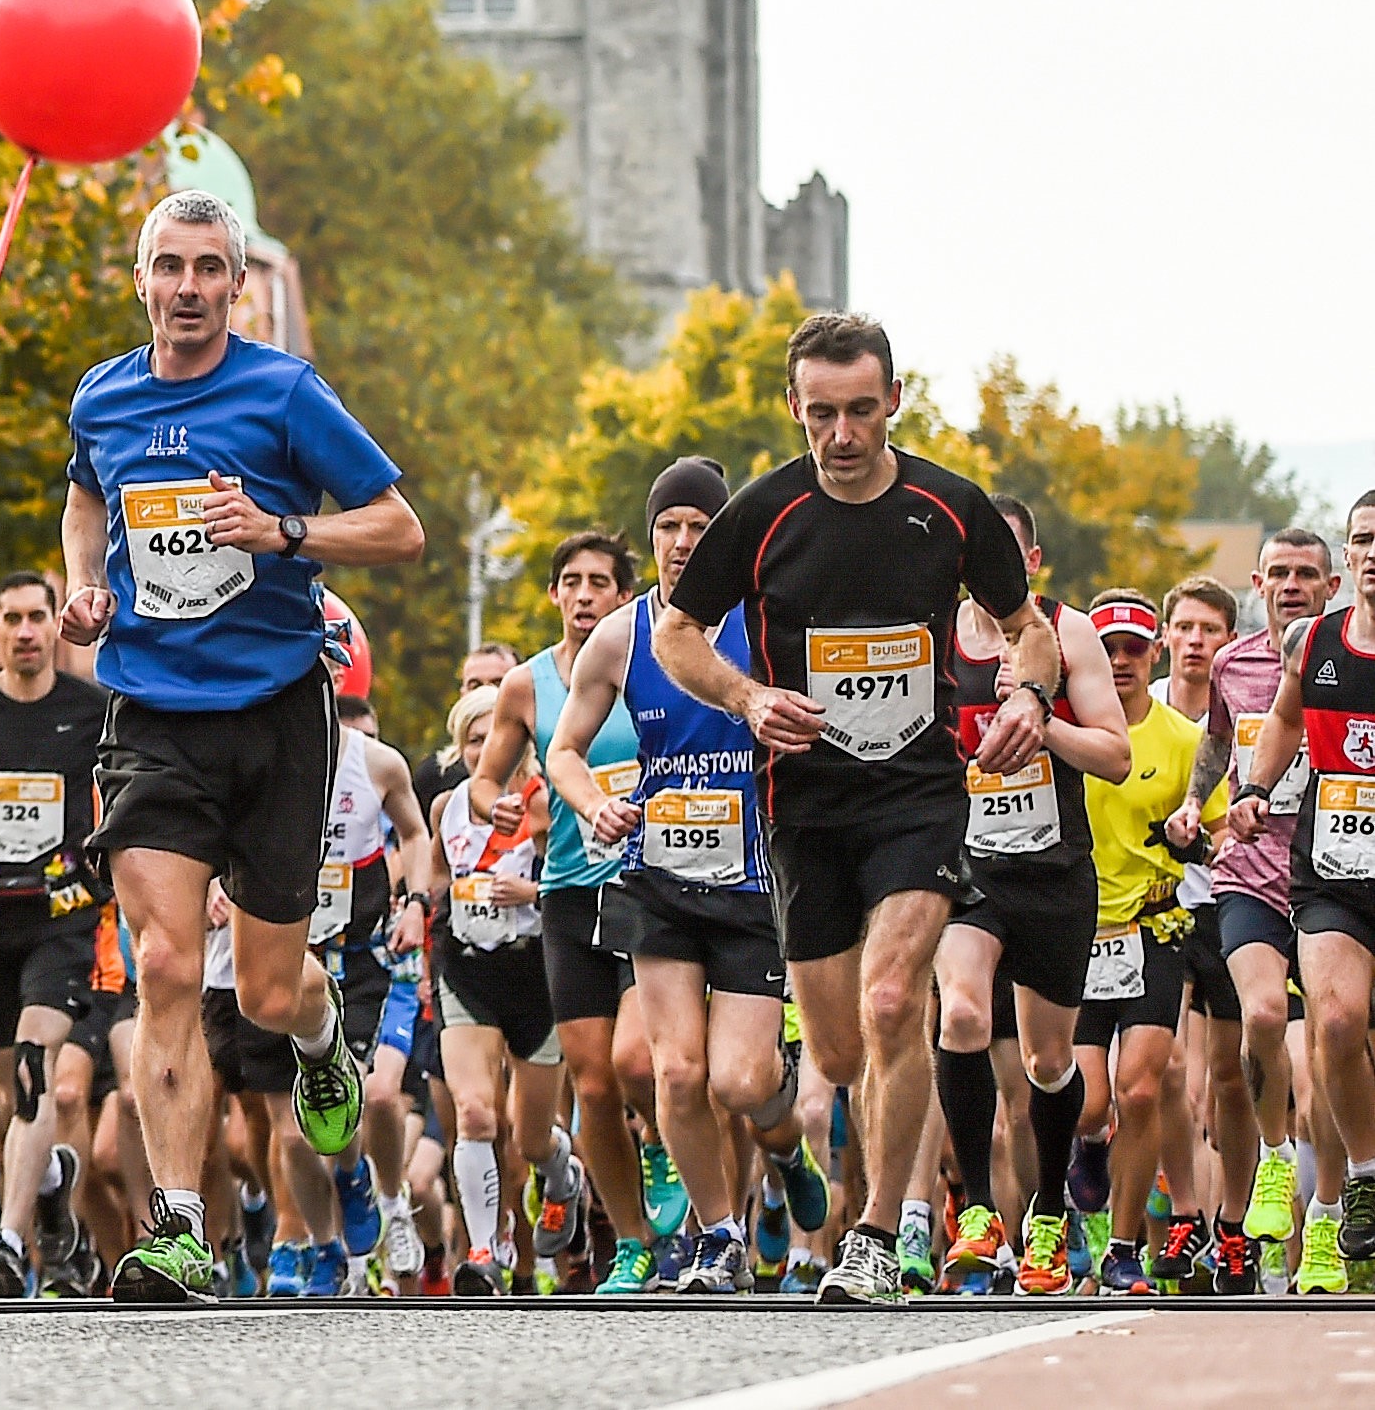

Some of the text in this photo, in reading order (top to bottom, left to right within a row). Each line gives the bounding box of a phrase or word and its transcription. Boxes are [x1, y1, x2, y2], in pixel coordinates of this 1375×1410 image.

[871, 643, 917, 656] DUBLIN
[835, 673, 910, 701] 4971
[2, 805, 40, 822] 324
[982, 792, 1035, 817] 2511
[660, 828, 721, 849] 1395
